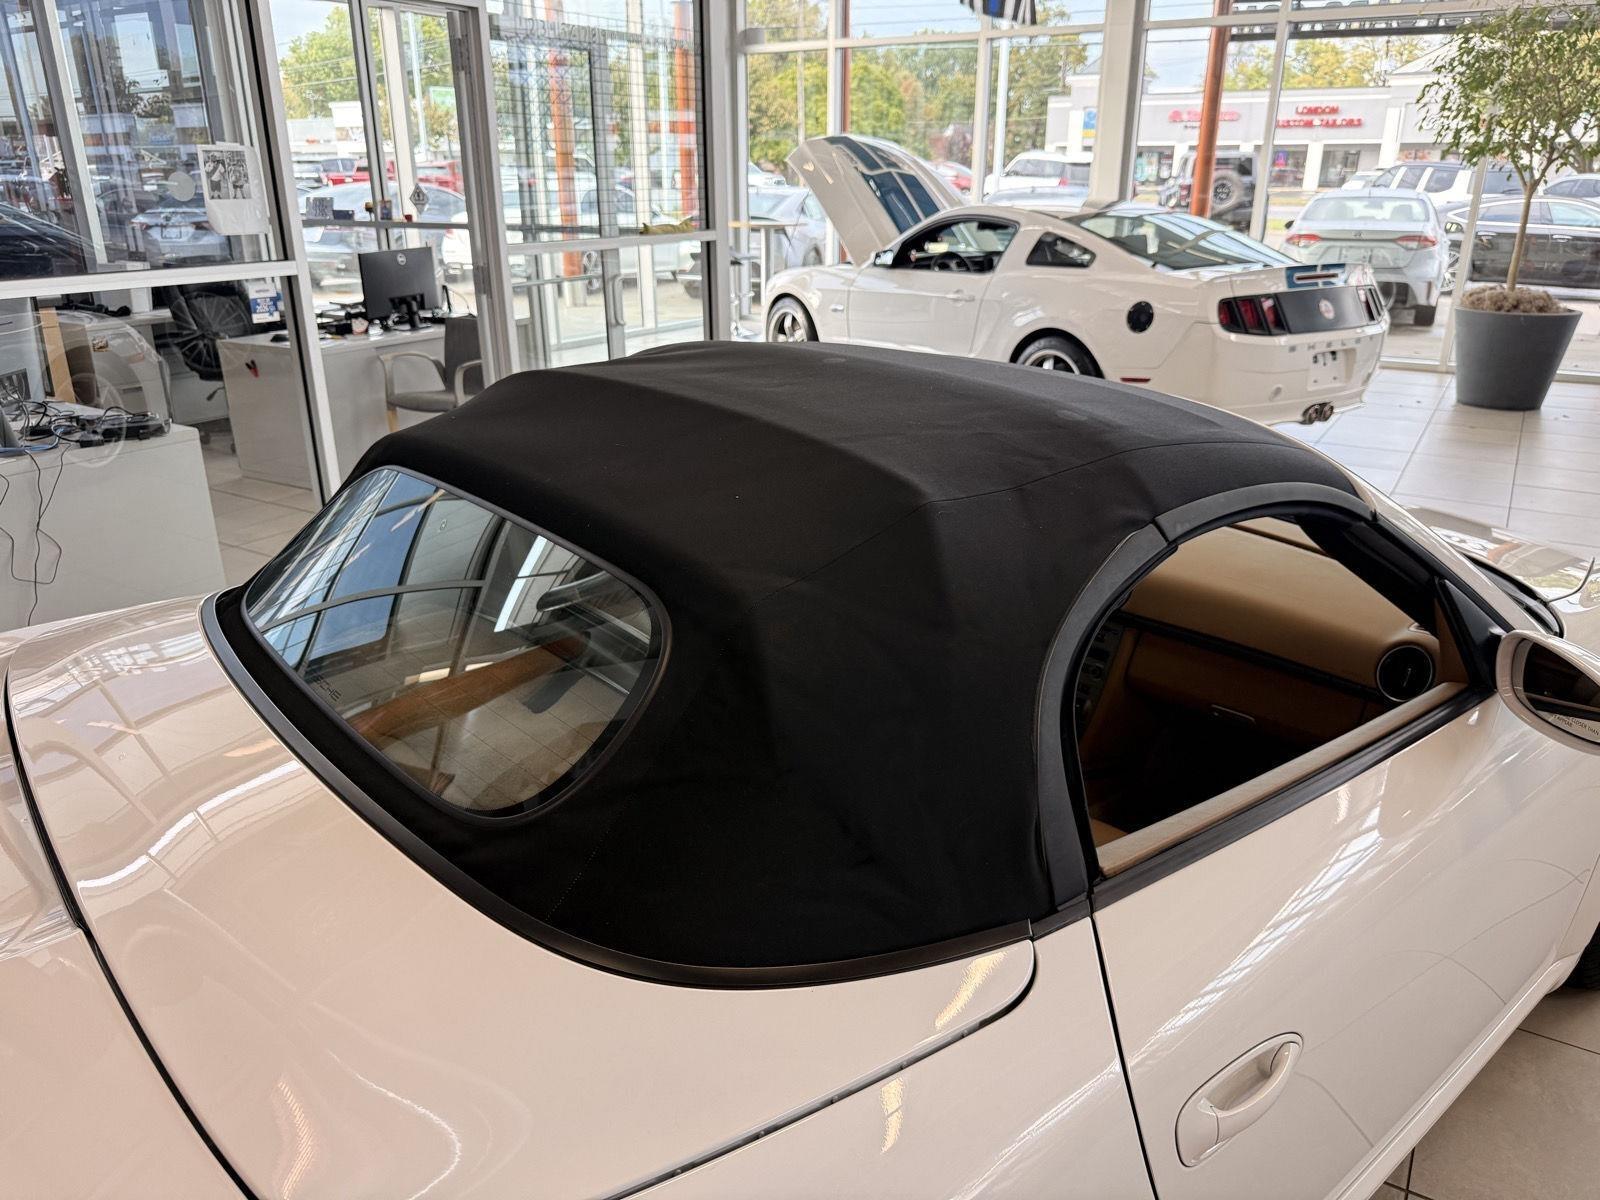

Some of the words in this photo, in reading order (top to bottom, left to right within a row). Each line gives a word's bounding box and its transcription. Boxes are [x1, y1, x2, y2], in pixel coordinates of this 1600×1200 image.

[1296, 105, 1339, 115] LONDON
[1276, 119, 1314, 128] USTOM
[1320, 118, 1363, 128] TAILORS
[1571, 717, 1587, 729] CLOSER
[1588, 726, 1600, 736] THAN
